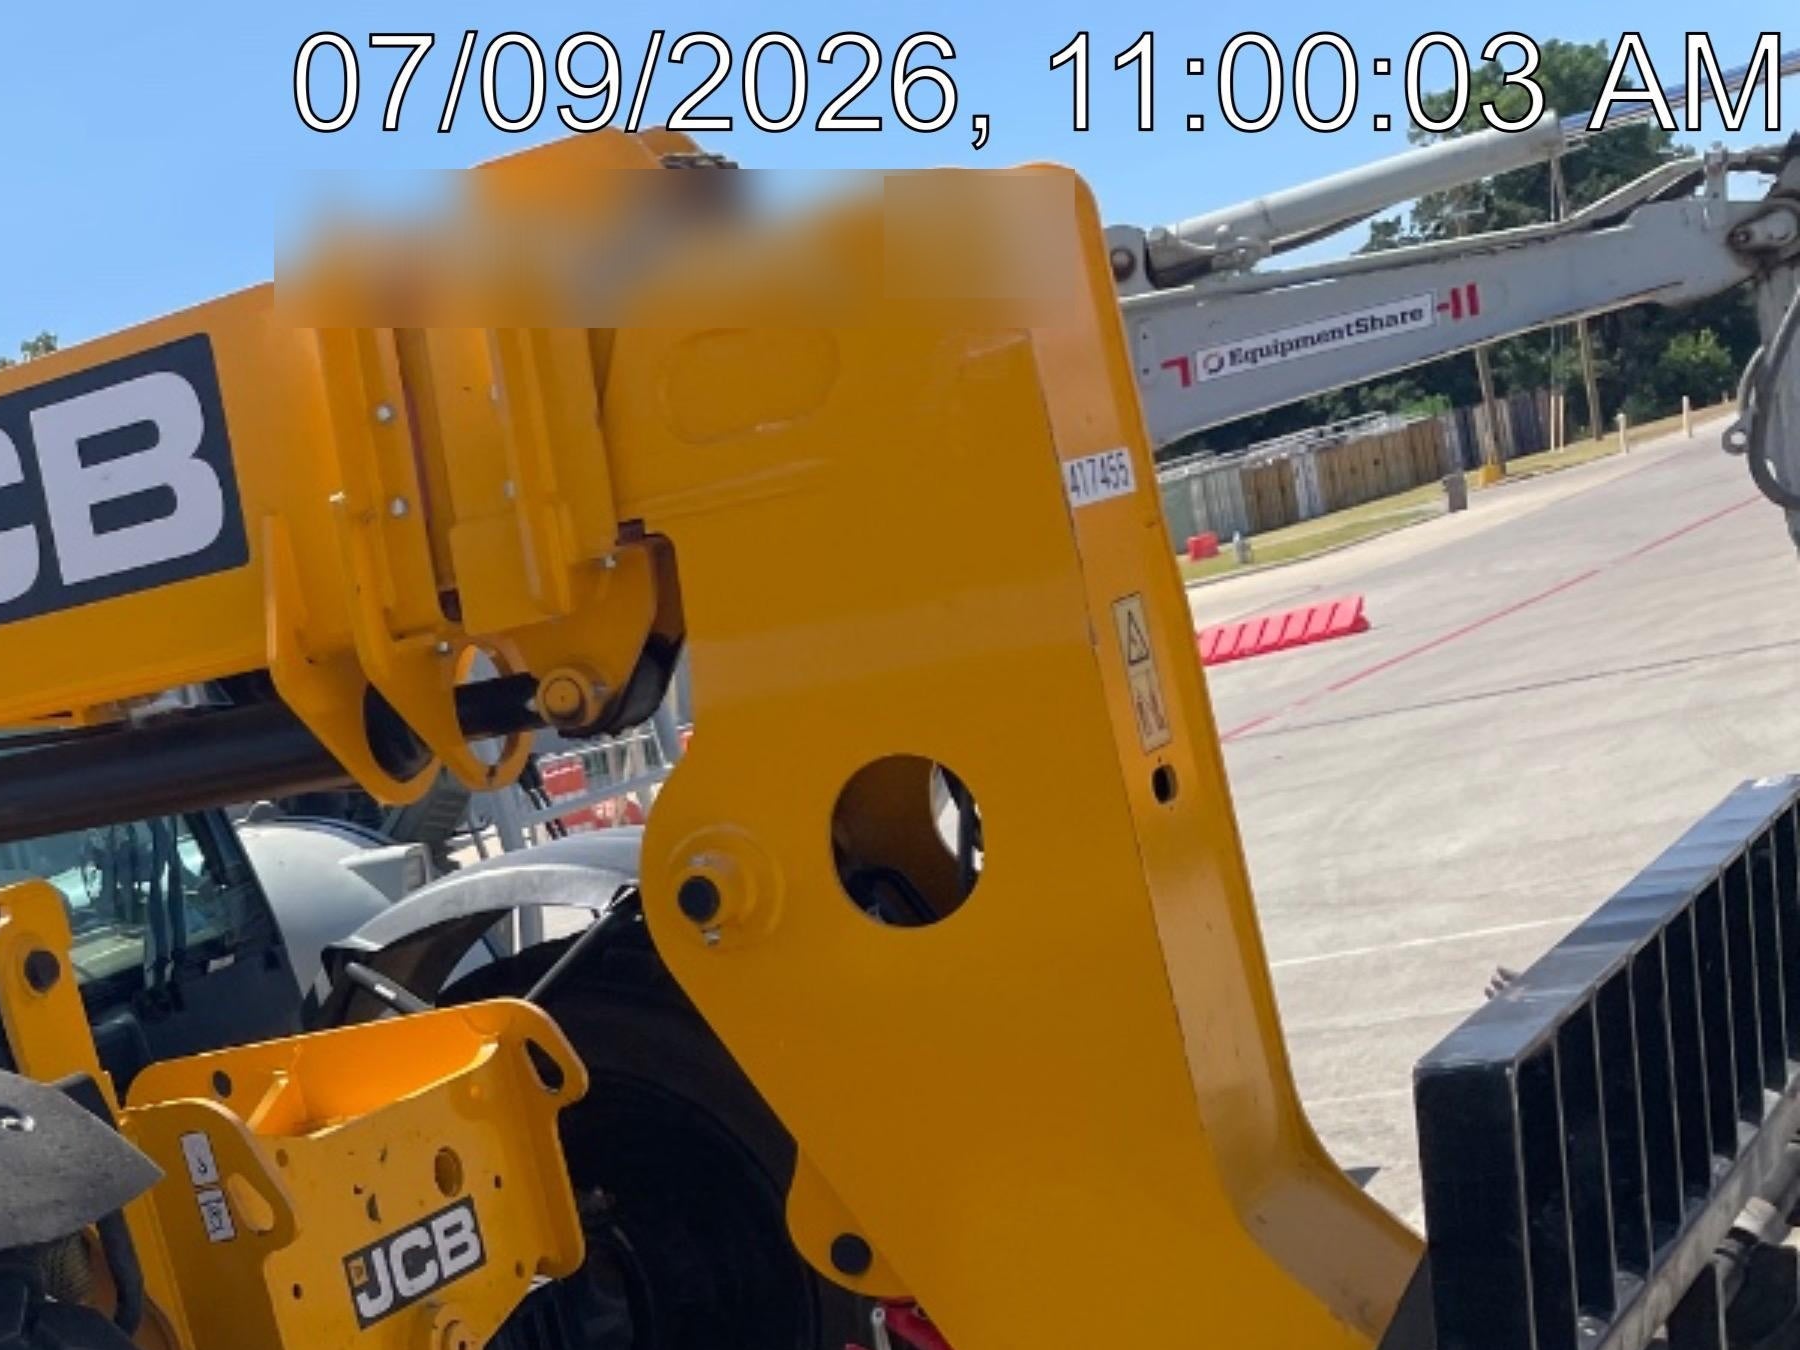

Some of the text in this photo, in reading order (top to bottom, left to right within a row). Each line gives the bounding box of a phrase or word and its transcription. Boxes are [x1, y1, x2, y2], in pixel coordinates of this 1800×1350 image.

[1228, 306, 1425, 368] EquipmentShare
[1069, 450, 1130, 500] 417455
[356, 1206, 481, 1318] JCB
